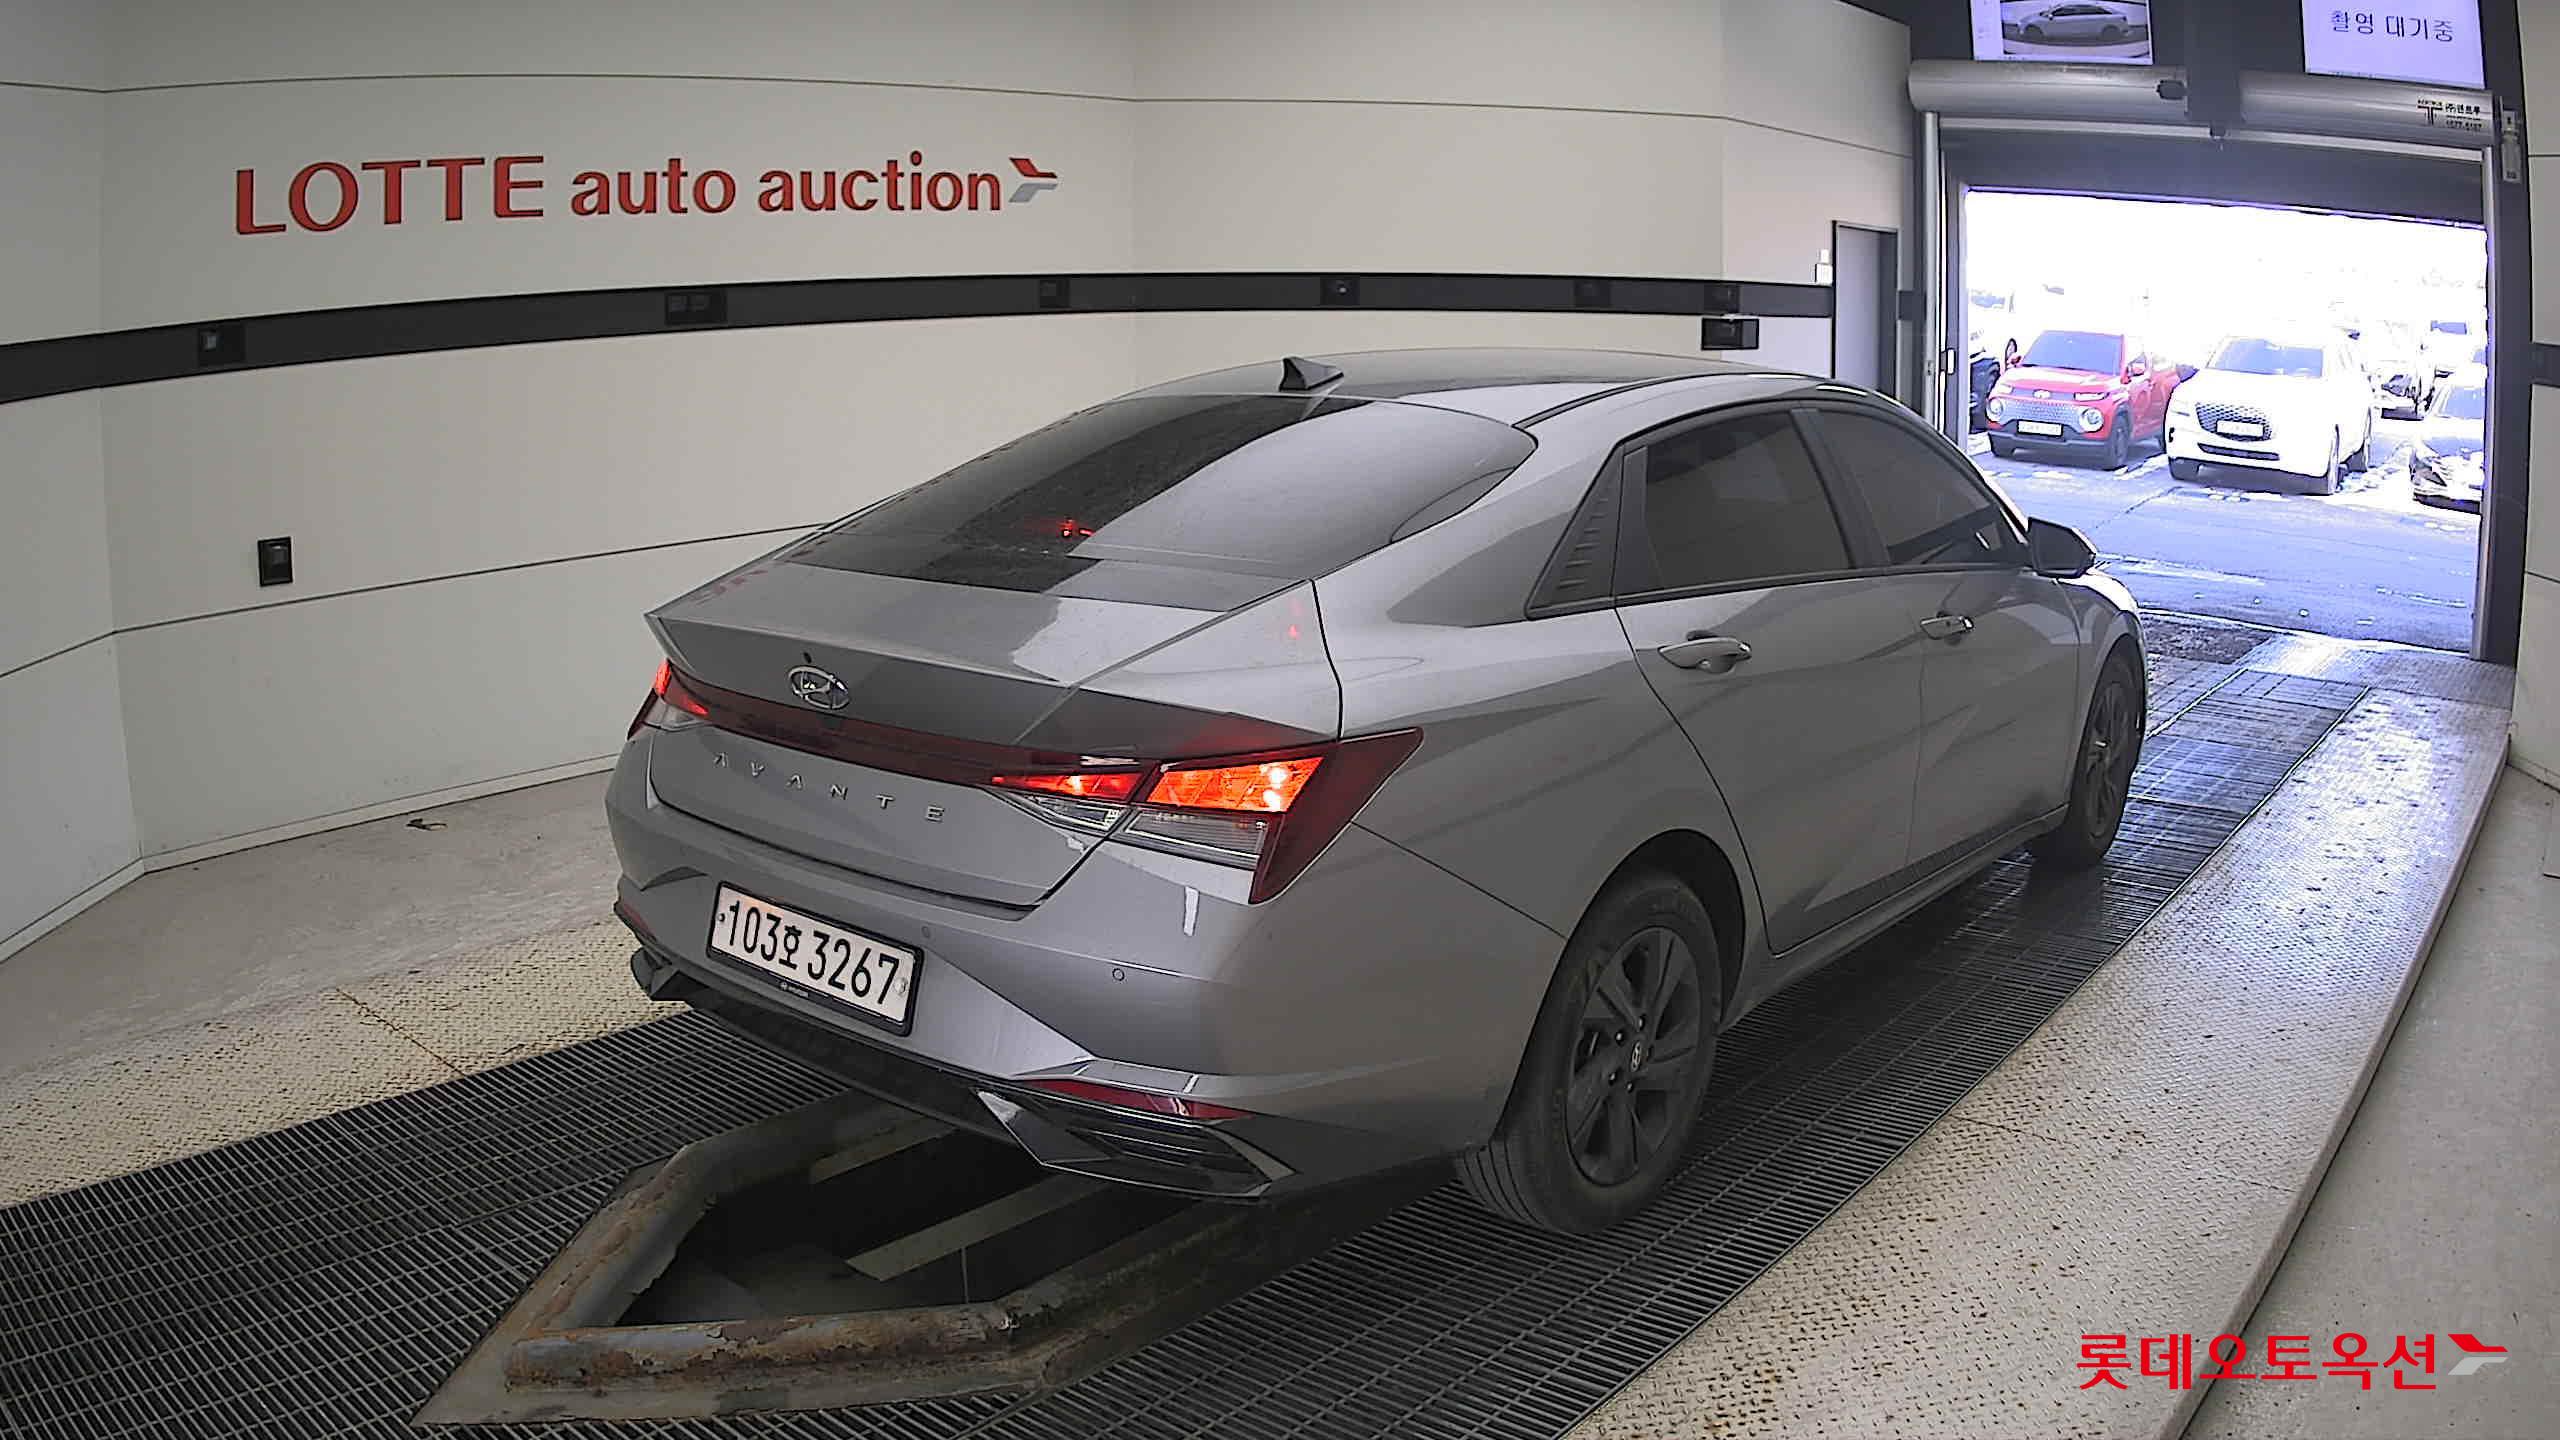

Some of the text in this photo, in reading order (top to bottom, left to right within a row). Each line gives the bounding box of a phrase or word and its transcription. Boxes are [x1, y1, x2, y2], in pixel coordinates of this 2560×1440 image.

[2330, 10, 2454, 43] 촬영 대기중
[237, 151, 1002, 234] LOTTE auto auction
[713, 752, 945, 822] AVANTE
